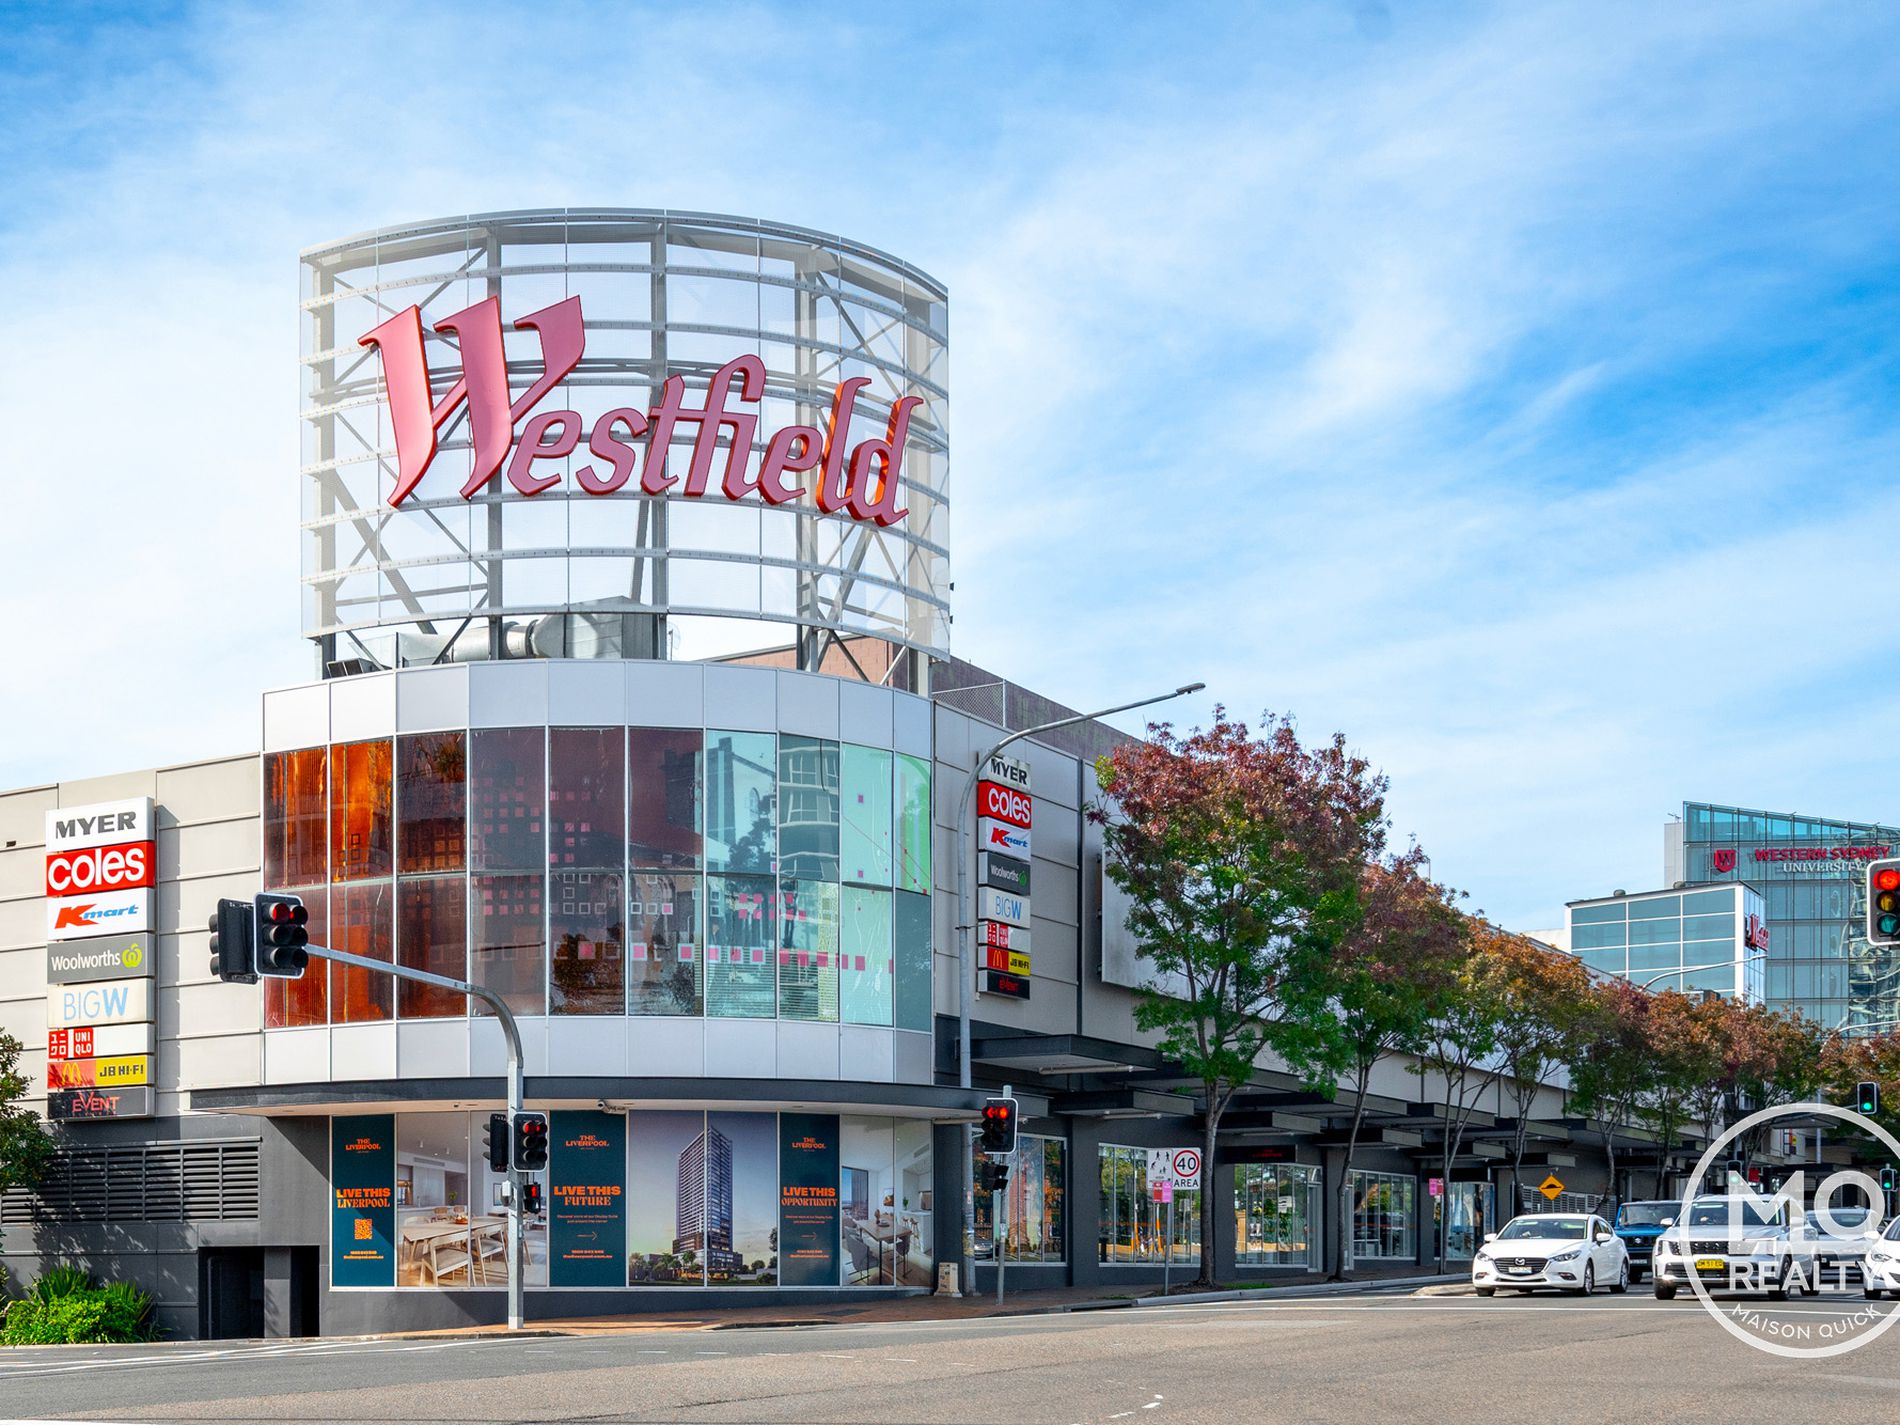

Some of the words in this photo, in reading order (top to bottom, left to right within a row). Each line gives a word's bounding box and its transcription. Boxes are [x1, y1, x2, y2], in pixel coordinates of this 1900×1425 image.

[357, 295, 924, 528] Westfield
[990, 758, 1028, 785] MYER
[988, 787, 1030, 823] coles
[55, 811, 137, 840] MYER
[991, 827, 1028, 848] Kmart
[1755, 848, 1827, 861] WESTERN
[1830, 846, 1889, 861] SYDNEY
[48, 848, 145, 891] coles
[1783, 860, 1866, 873] UNIVERSITY
[54, 903, 139, 929] Kmart
[51, 952, 121, 971] Woolworths
[100, 1066, 116, 1077] JB
[72, 1091, 120, 1113] EVENT
[1177, 1157, 1196, 1170] 40
[1174, 1179, 1198, 1187] AREA
[336, 1188, 362, 1198] LIVE
[363, 1188, 391, 1197] THIS
[554, 1186, 585, 1195] LIVE
[587, 1186, 621, 1195] THIS
[782, 1187, 808, 1196] LIVE
[809, 1187, 836, 1196] THIS
[337, 1198, 390, 1208] LIVERPOOL
[564, 1196, 611, 1206] FUTURE
[781, 1198, 837, 1206] OPPORTUNITY
